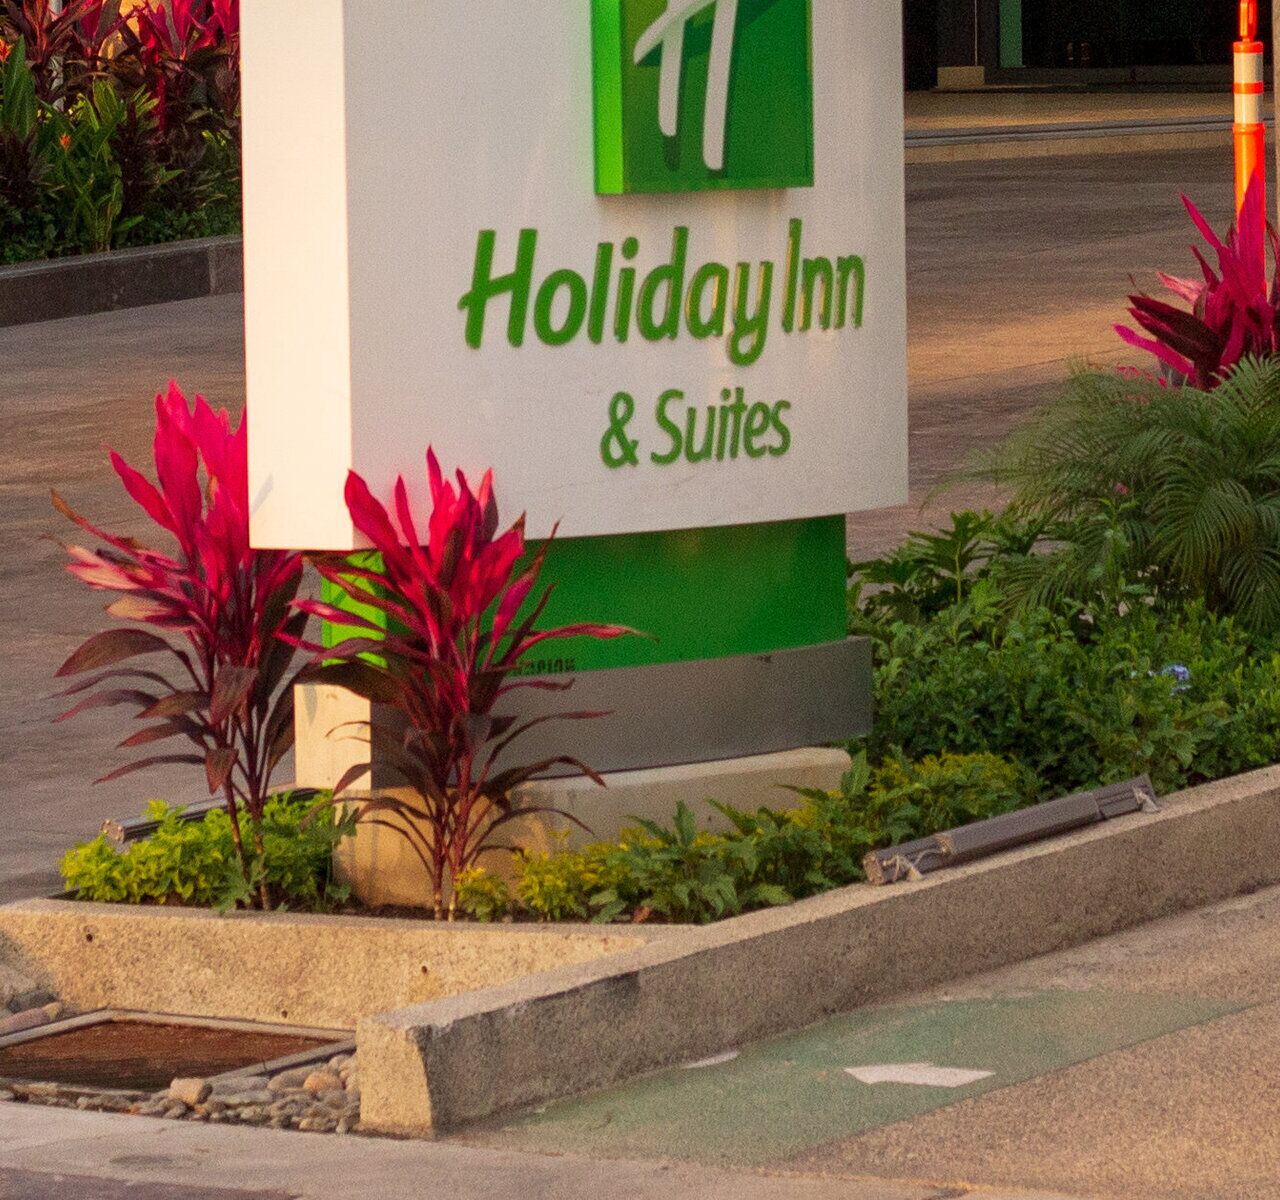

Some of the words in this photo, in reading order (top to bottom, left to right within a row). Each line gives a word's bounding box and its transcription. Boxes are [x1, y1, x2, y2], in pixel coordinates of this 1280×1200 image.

[457, 225, 774, 367] Holiday
[781, 218, 866, 334] Inn
[600, 391, 640, 469] &
[650, 387, 792, 466] Suites
